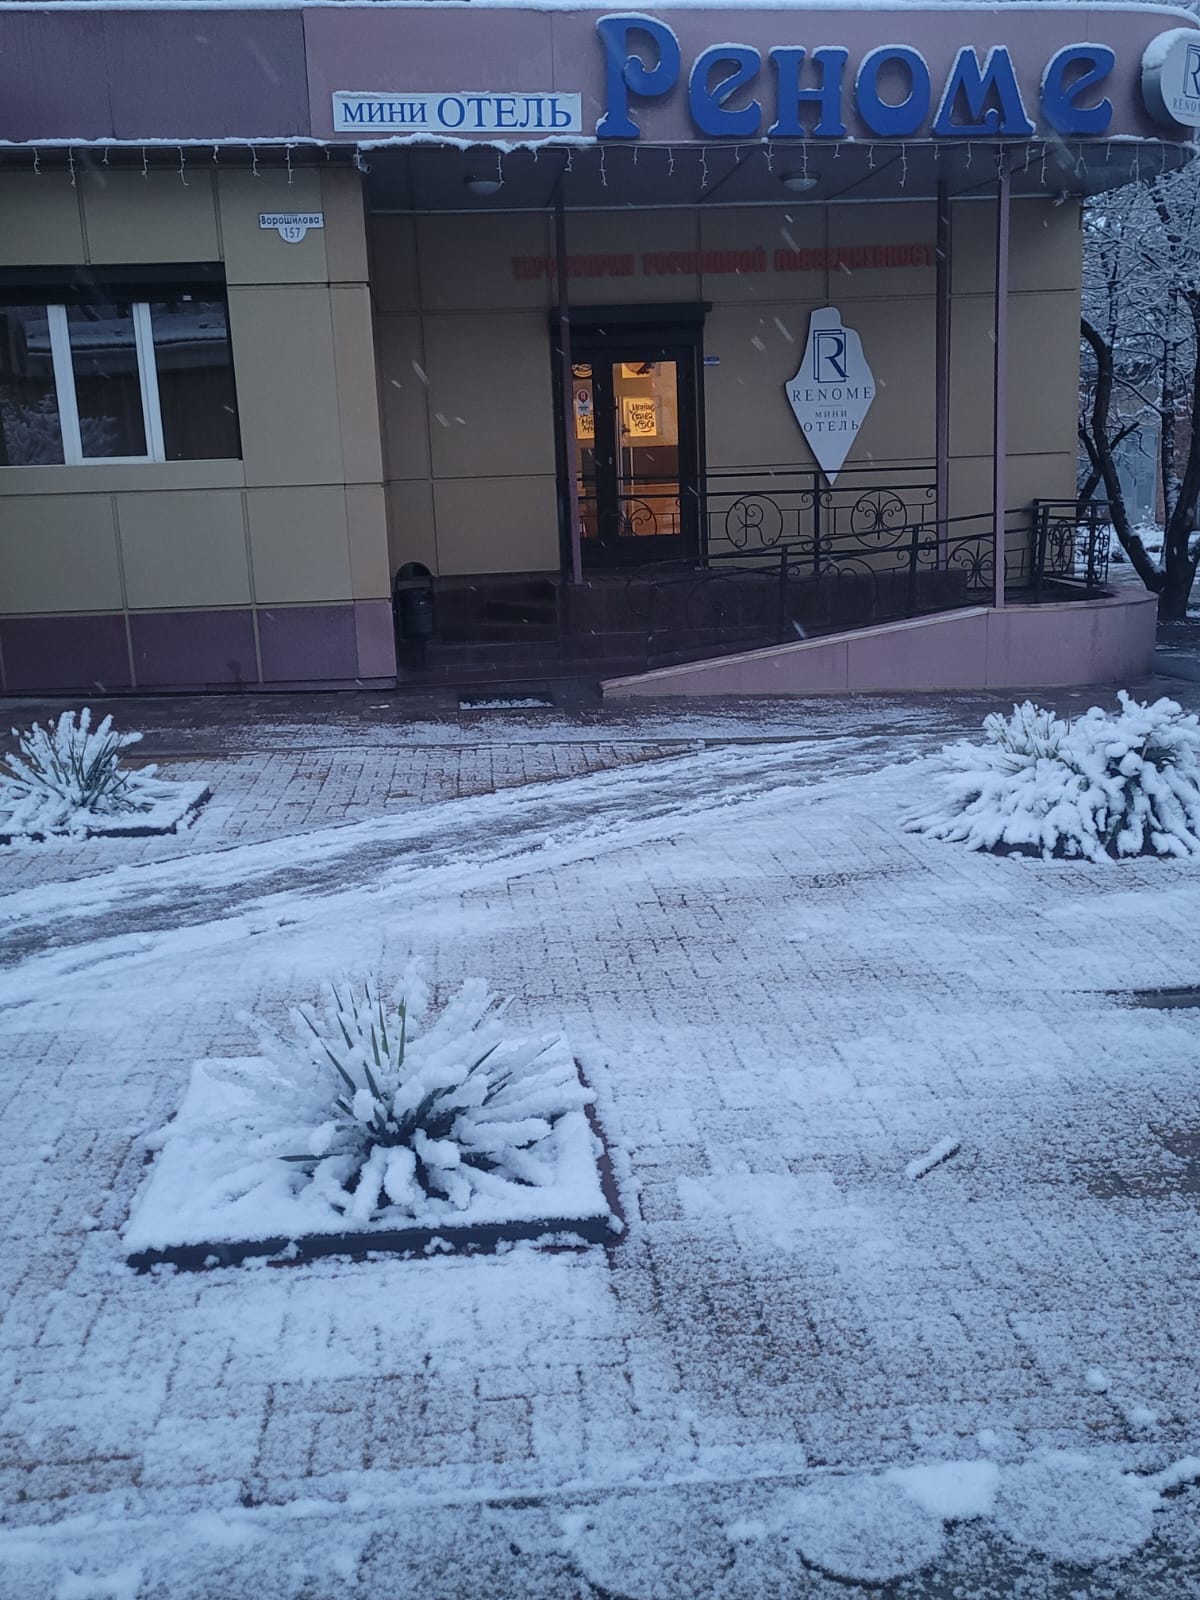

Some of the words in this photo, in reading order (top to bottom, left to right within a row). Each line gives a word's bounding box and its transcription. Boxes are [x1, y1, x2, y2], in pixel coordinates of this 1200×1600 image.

[1173, 97, 1200, 113] RENO
[437, 97, 572, 128] ОТЕЛЬ
[261, 215, 320, 226] Ворошилова
[284, 227, 300, 239] 157
[792, 386, 873, 402] RENOME
[803, 420, 859, 433] ОТЕЛЬ
